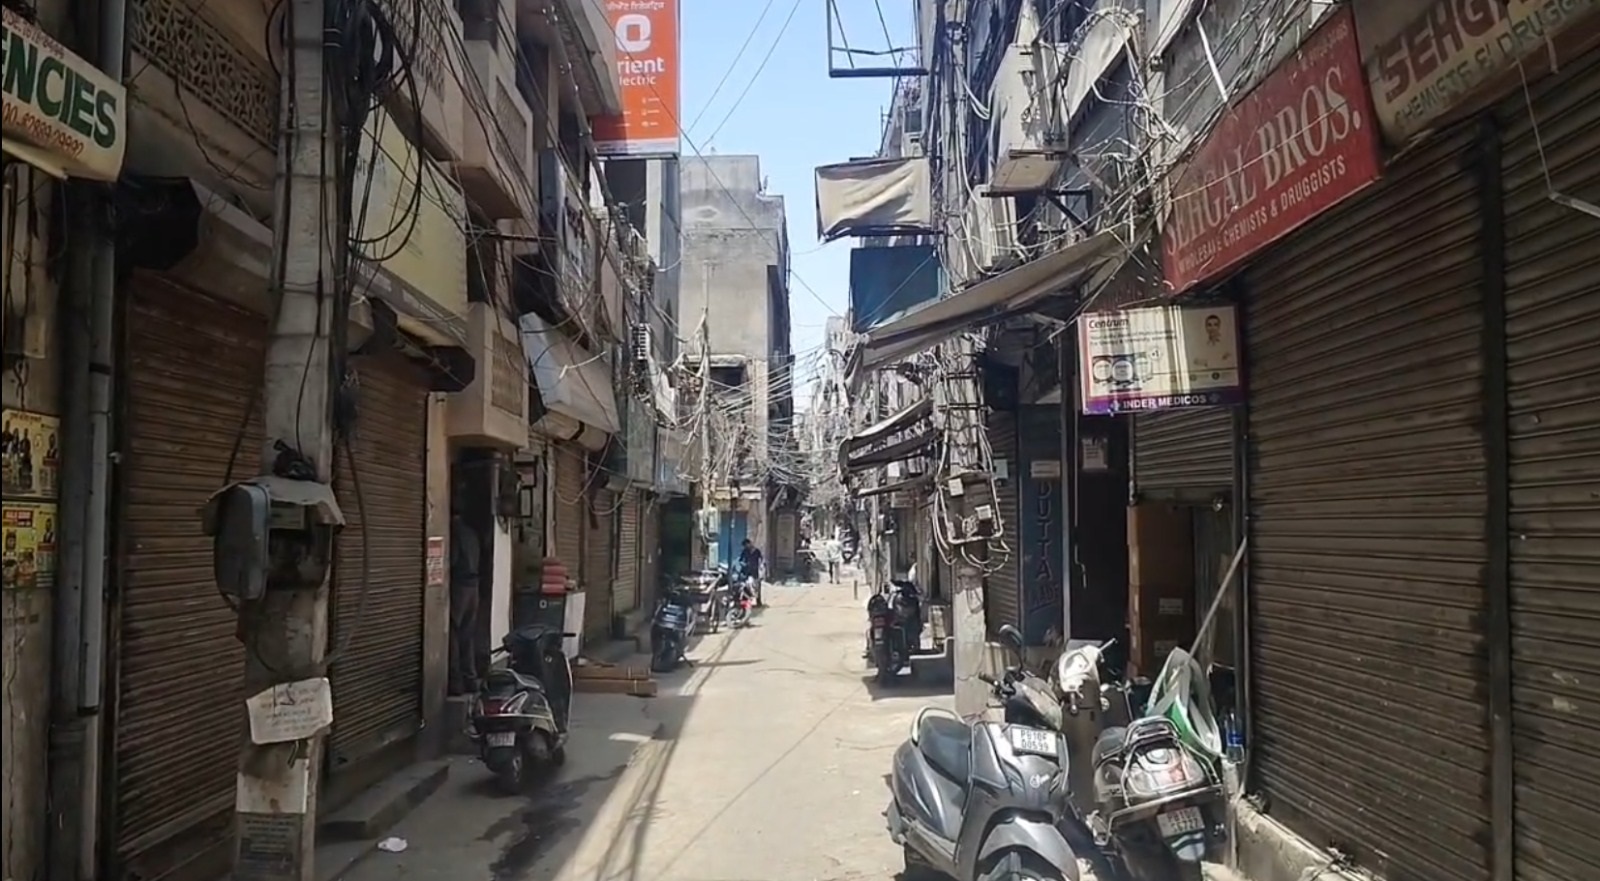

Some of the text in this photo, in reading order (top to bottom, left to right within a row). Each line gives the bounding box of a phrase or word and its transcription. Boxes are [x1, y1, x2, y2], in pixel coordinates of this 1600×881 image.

[1257, 66, 1361, 191] BROS.
[1223, 206, 1268, 247] CHEMISTS
[1270, 199, 1279, 218] &
[1280, 157, 1347, 211] DRUGGISTS
[1088, 318, 1129, 329] Centrum
[1123, 394, 1207, 409] INDER MEDICOS
